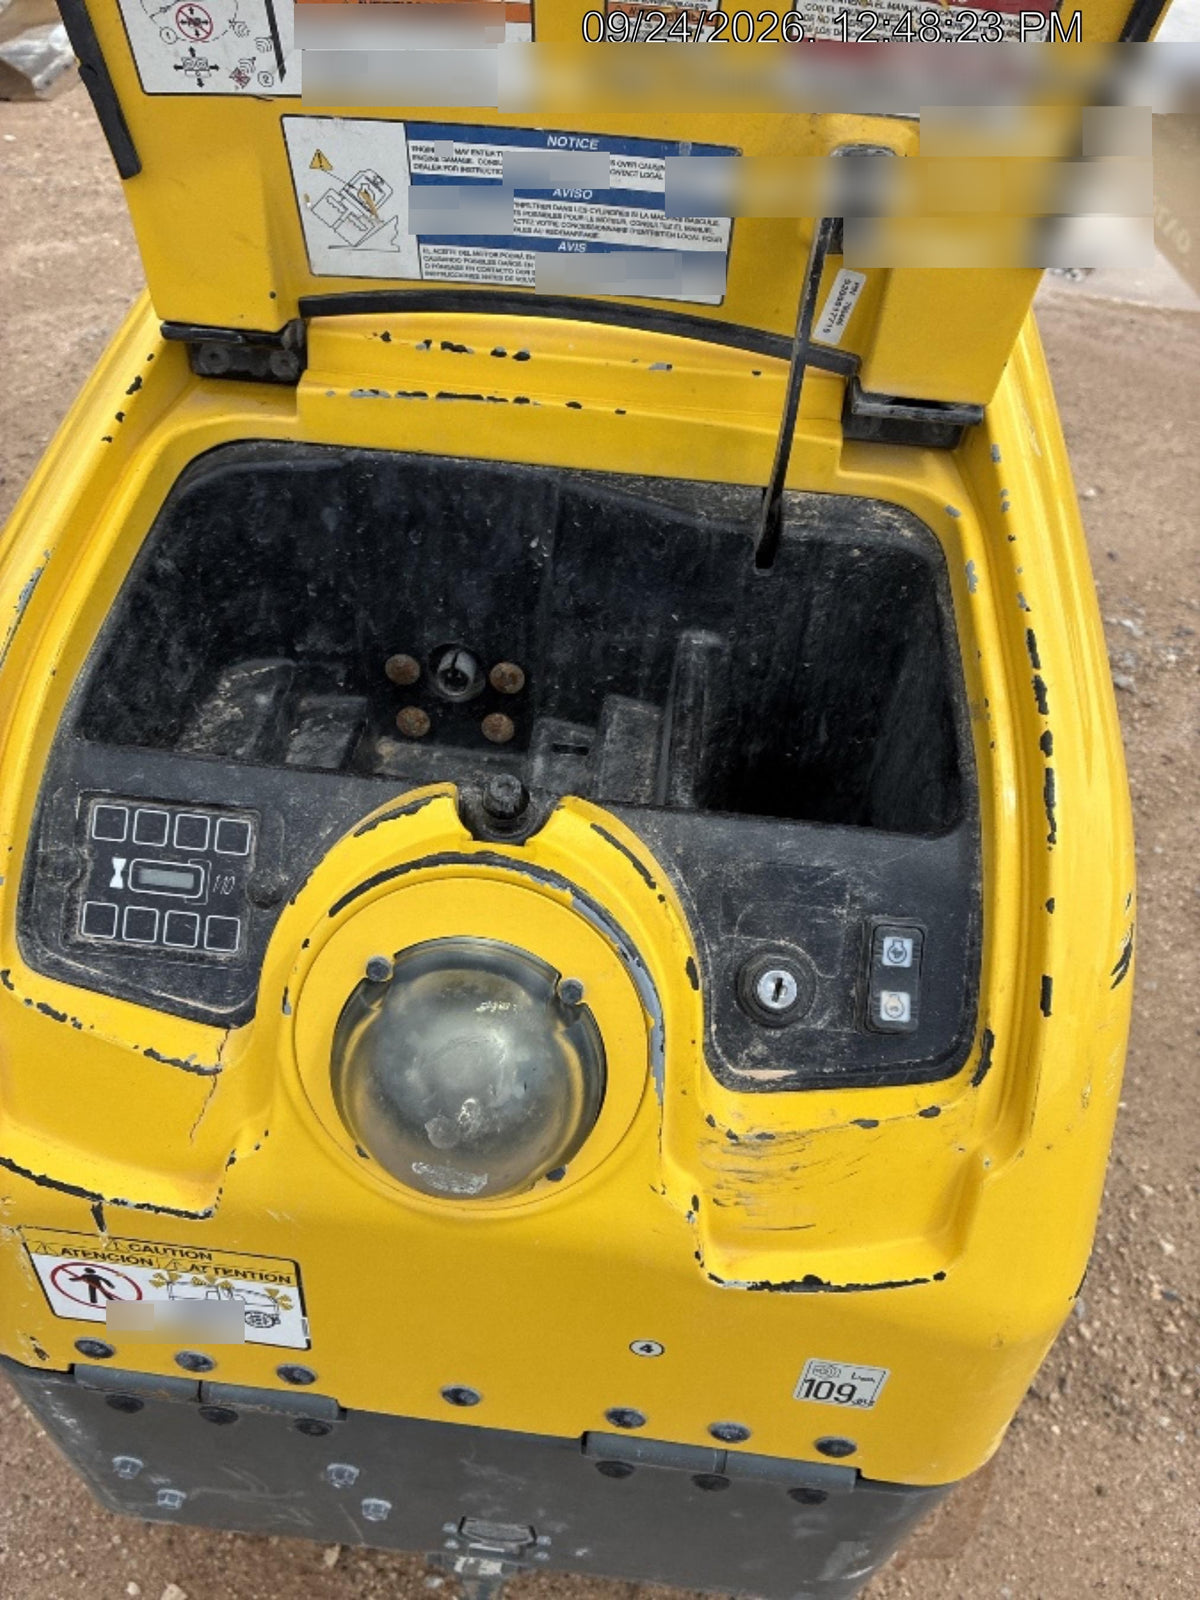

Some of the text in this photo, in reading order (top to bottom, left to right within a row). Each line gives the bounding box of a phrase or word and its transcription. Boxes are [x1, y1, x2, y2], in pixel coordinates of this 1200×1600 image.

[547, 135, 600, 150] NOTICE
[552, 189, 593, 199] AVISO
[558, 241, 587, 252] AVIS
[128, 1243, 212, 1261] CAUTION
[640, 1343, 653, 1353] 4
[803, 1378, 857, 1403] 109
